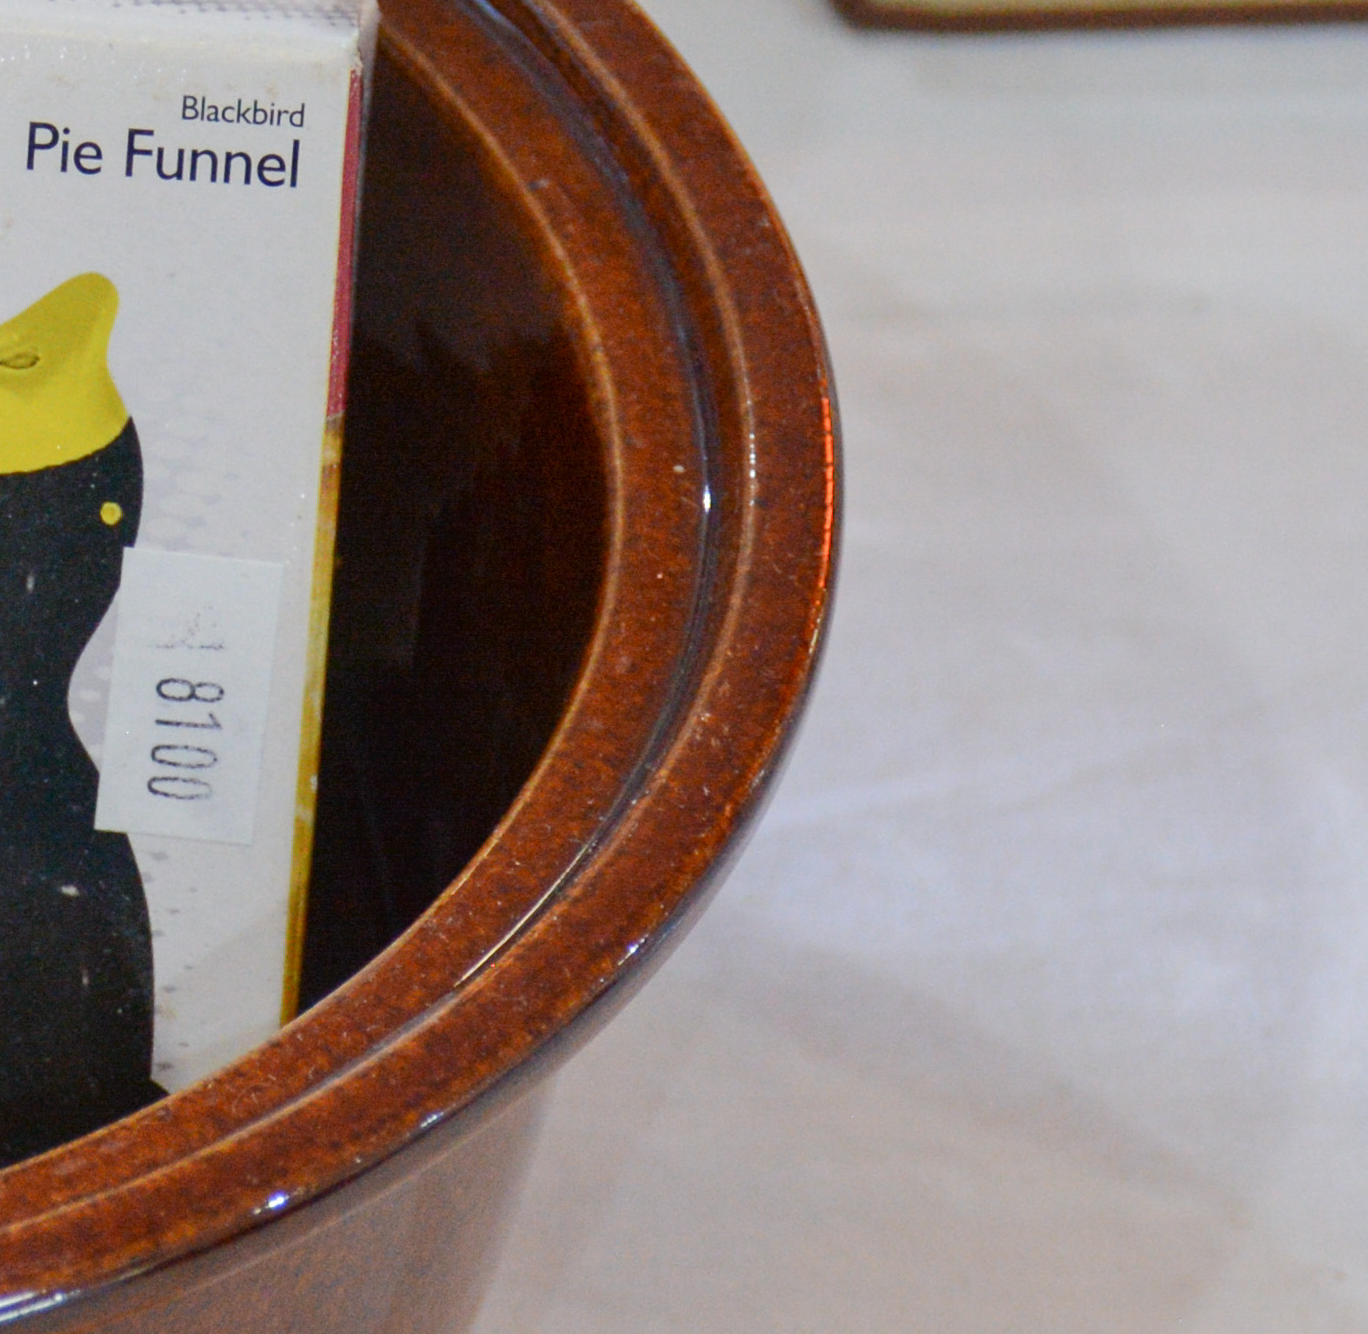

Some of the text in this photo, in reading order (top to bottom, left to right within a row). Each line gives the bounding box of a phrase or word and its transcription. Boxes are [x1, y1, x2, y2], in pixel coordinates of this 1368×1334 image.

[181, 93, 305, 128] Blackbird
[26, 121, 301, 188] Pie Funnel
[147, 678, 225, 801] 8100
